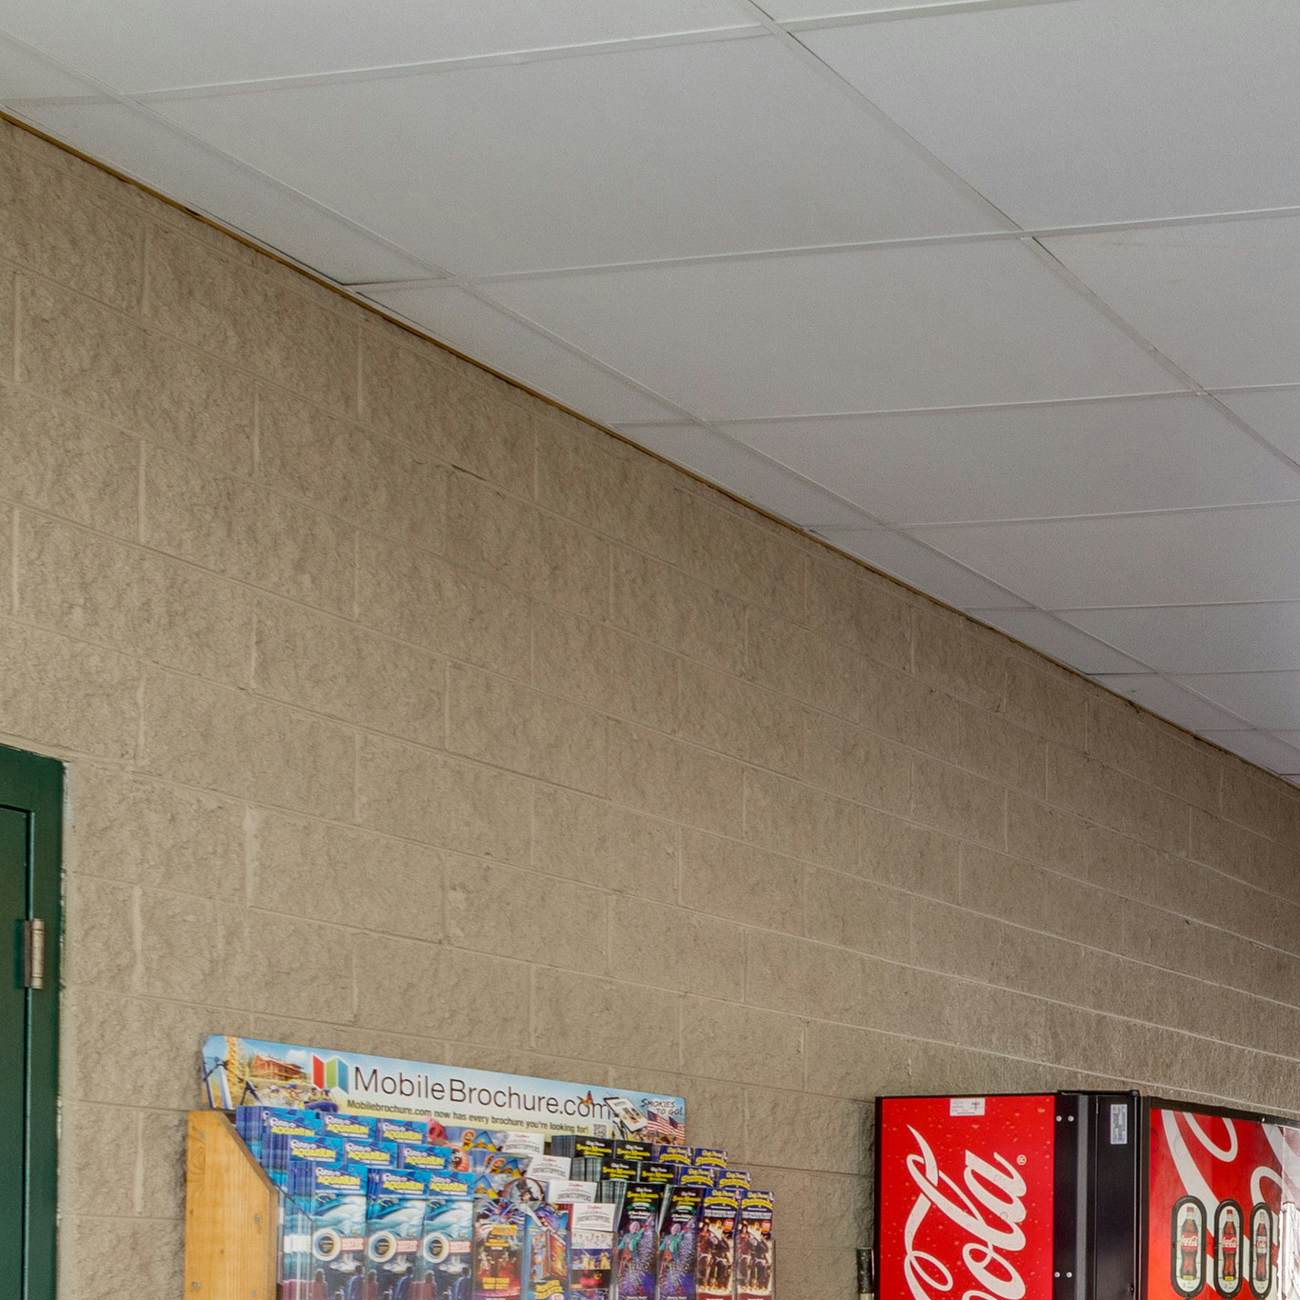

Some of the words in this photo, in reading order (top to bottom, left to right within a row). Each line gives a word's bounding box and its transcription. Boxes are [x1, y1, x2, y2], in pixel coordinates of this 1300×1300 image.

[355, 1066, 613, 1120] MobileBrochure.com
[433, 1109, 450, 1120] now
[453, 1111, 467, 1121] has
[469, 1115, 490, 1125] every
[491, 1115, 524, 1128] brochure
